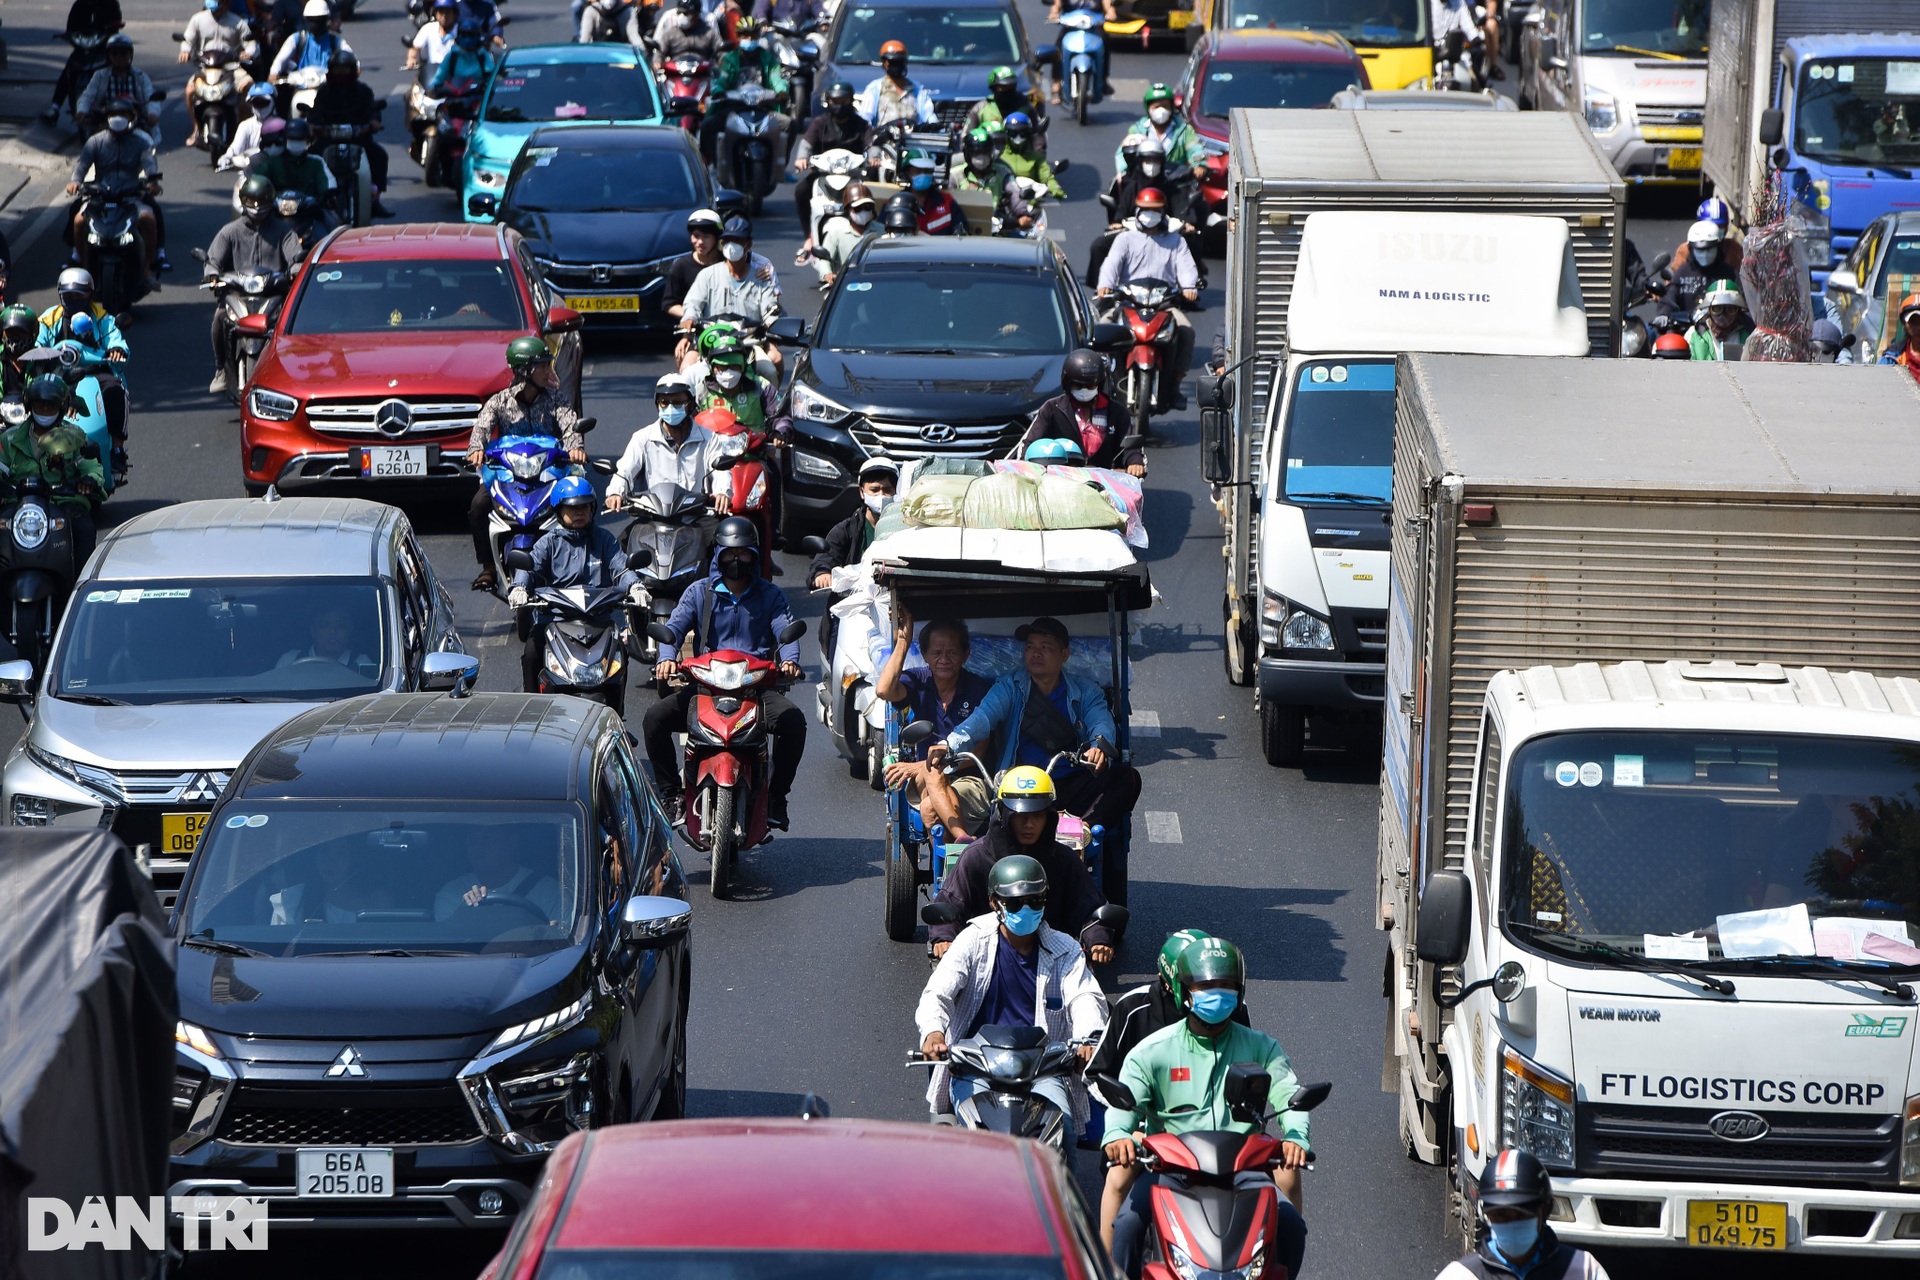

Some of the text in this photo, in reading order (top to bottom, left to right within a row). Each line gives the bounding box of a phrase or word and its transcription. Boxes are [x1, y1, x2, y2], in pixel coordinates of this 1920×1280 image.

[1379, 231, 1498, 264] ISUZU
[1379, 289, 1410, 299] NAM
[1424, 291, 1491, 303] LOGISTIC
[386, 449, 411, 462] 72A
[376, 462, 421, 475] 626.07
[1017, 776, 1037, 790] be
[186, 816, 206, 831] 84
[1200, 949, 1227, 959] Grab
[1160, 952, 1176, 979] Grab
[1578, 1006, 1662, 1022] VEAM MOTOR
[1601, 1073, 1884, 1106] FT LOGISTICS CORP
[1715, 1118, 1762, 1135] VEAM
[325, 1152, 366, 1172] 66A
[308, 1174, 383, 1194] 205.08
[1716, 1203, 1758, 1223] 51D
[1698, 1225, 1776, 1247] 049.75
